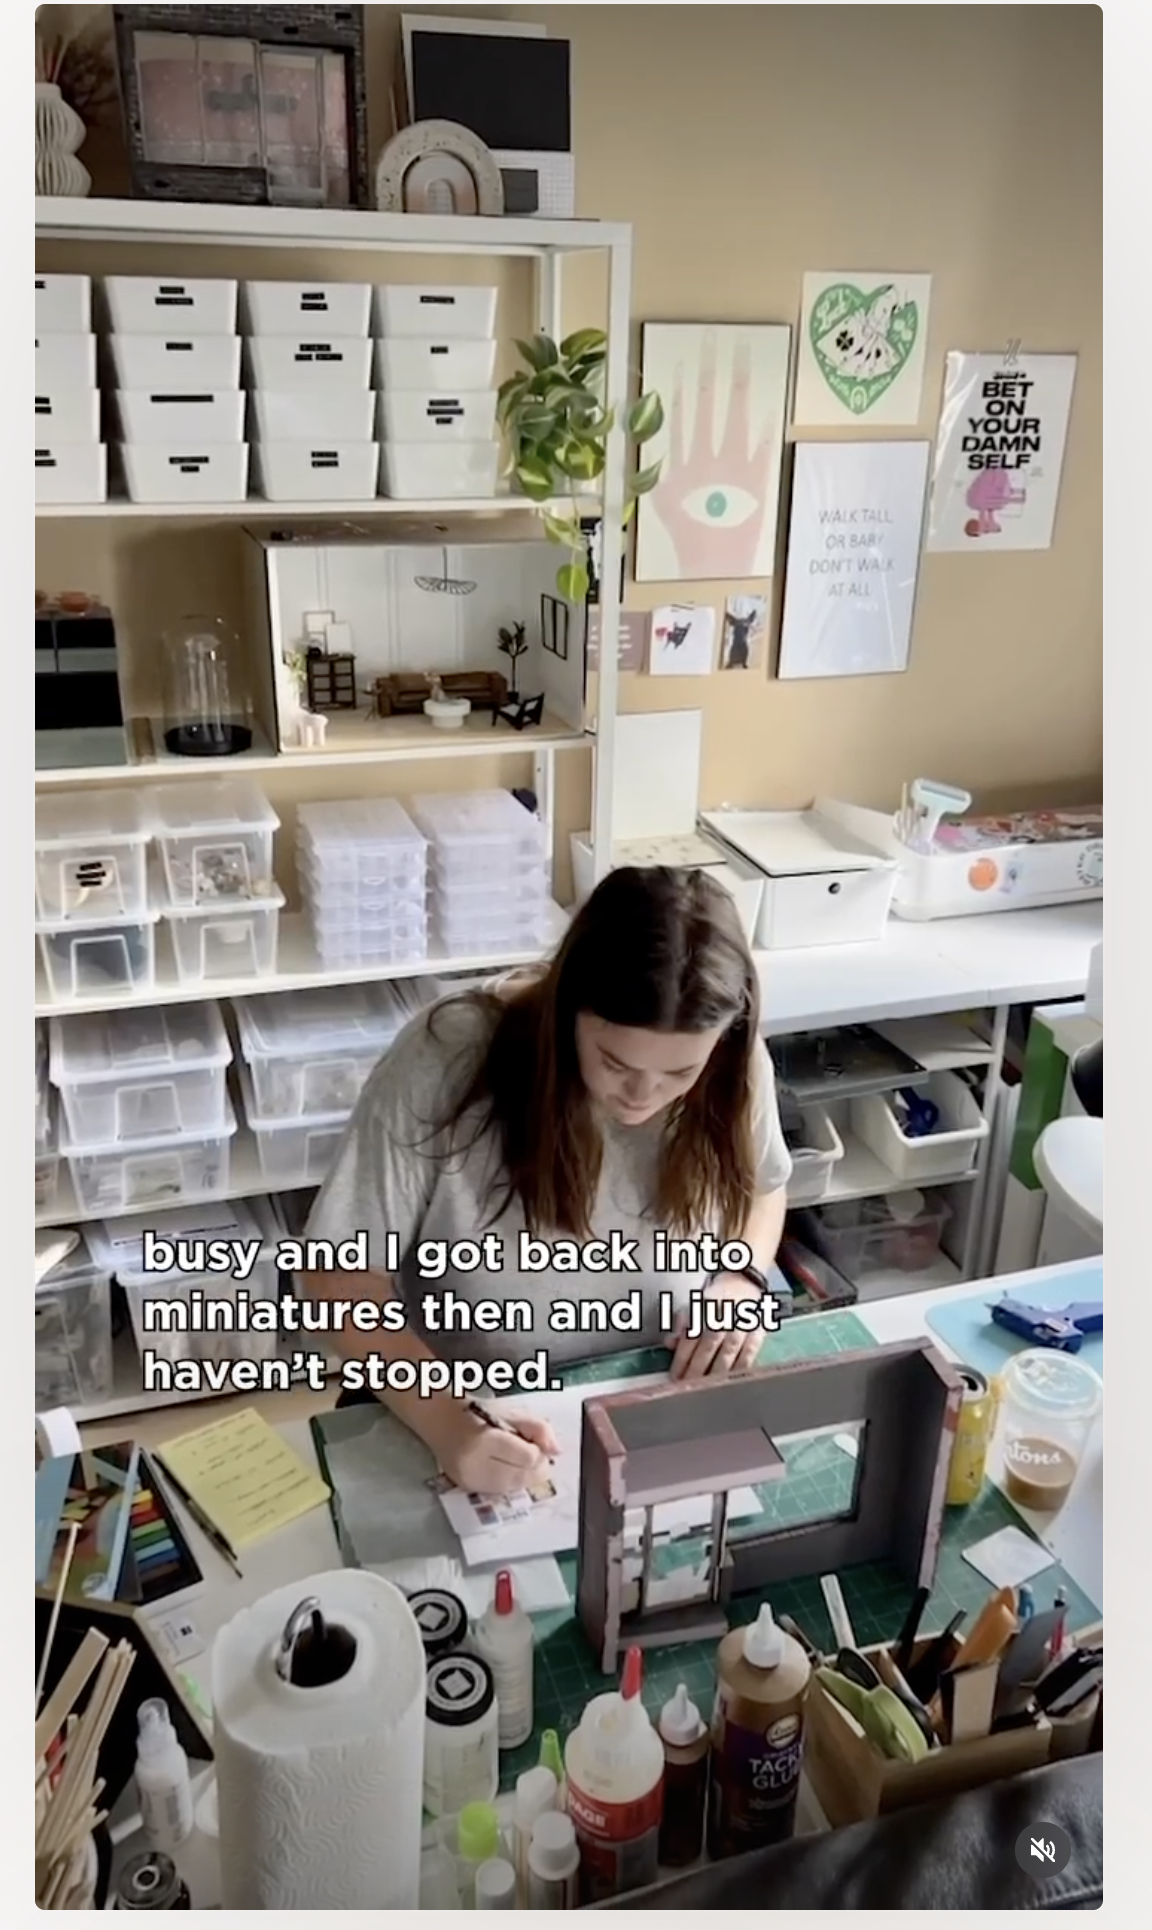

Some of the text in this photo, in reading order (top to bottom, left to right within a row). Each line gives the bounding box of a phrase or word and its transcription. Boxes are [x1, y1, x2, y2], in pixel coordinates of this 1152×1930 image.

[981, 381, 1035, 398] BET
[985, 399, 1026, 416] ON
[967, 417, 1041, 434] YOUR
[961, 435, 1042, 452] DAMN
[967, 453, 1032, 470] SELF
[818, 508, 895, 524] WALK TALL
[824, 532, 885, 551] OR BABY
[808, 558, 896, 576] DON'T WALK
[827, 582, 872, 598] AT ALL
